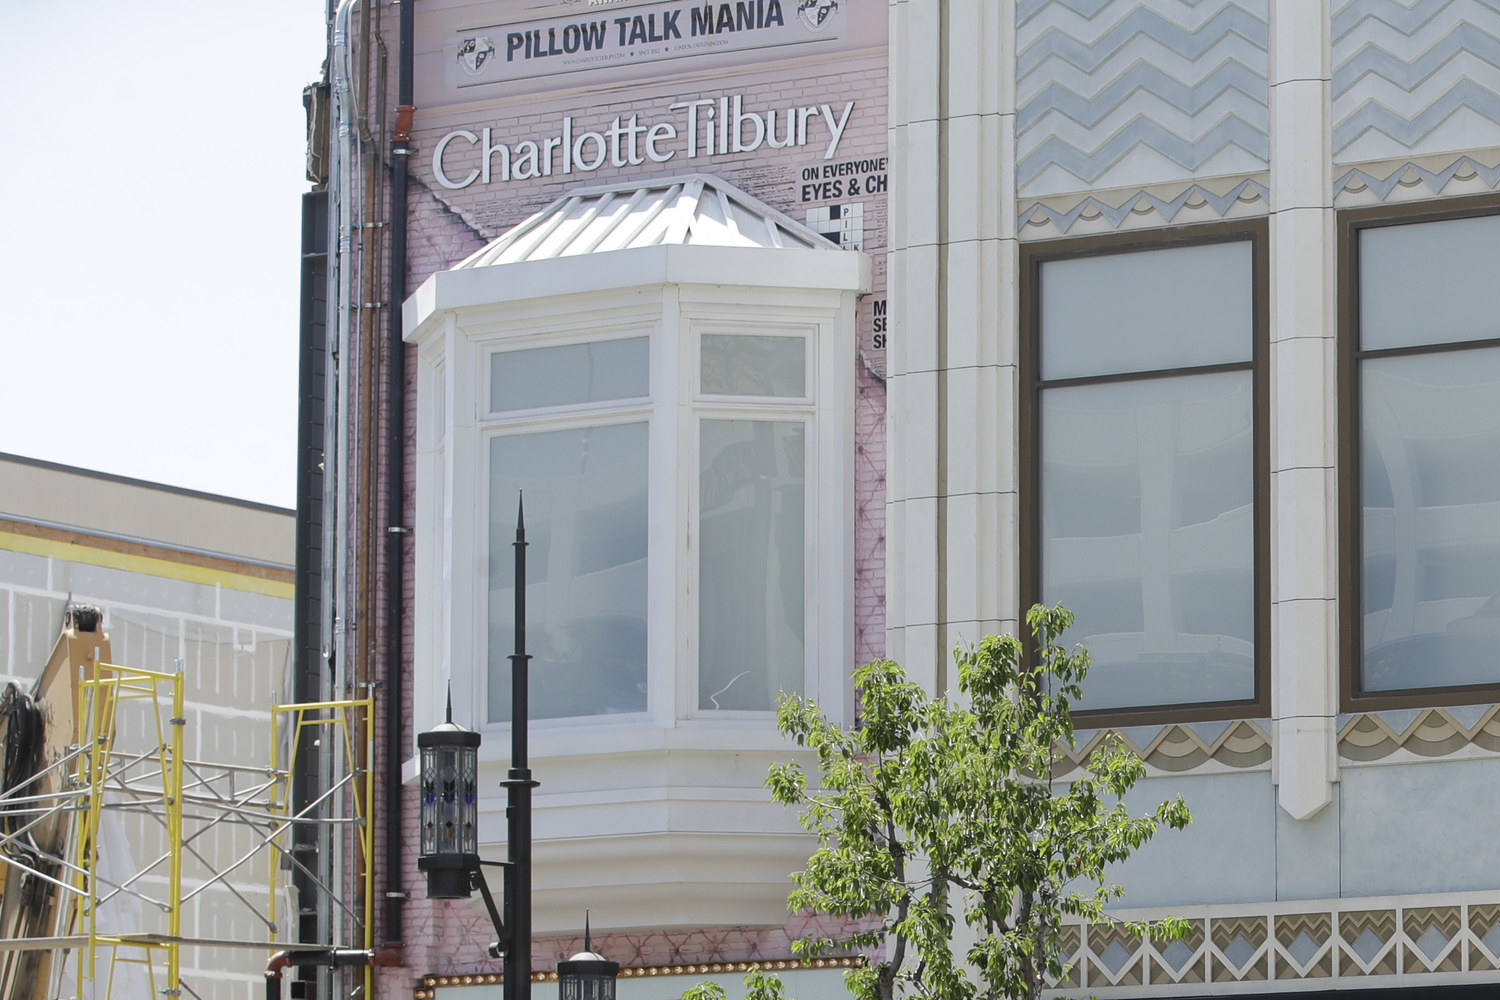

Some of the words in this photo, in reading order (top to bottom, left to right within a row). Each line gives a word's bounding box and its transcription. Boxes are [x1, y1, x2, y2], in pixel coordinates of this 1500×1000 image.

[506, 20, 606, 61] PILLOW
[614, 9, 682, 46] TALK
[690, 0, 784, 37] MANIA
[802, 167, 819, 180] ON
[802, 180, 842, 202] EYES
[848, 178, 860, 197] &
